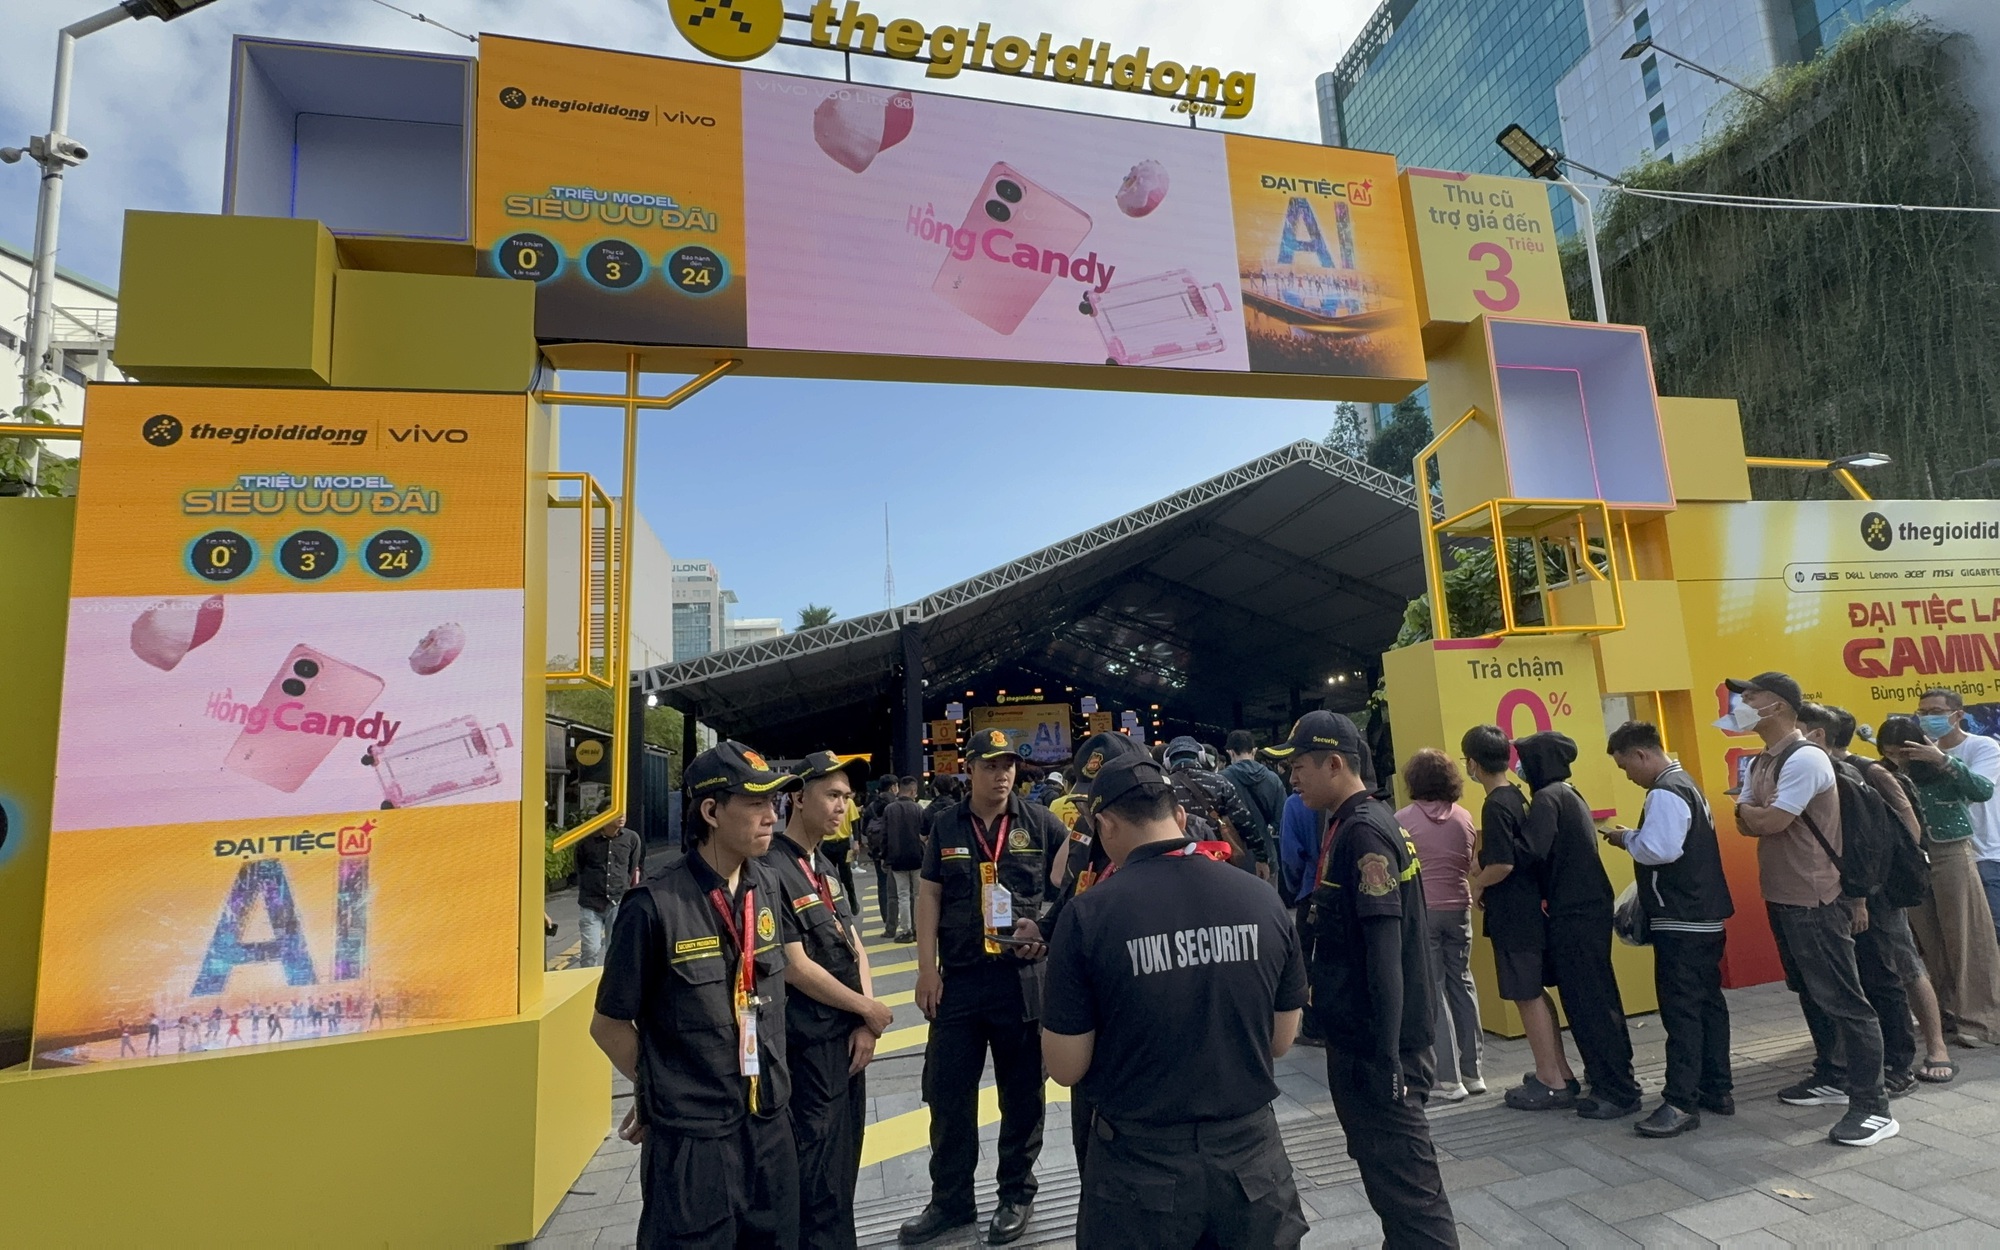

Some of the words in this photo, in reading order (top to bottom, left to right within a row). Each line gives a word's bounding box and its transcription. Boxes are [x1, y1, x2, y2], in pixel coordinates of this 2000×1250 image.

[810, 0, 1256, 119] thegioididong
[531, 95, 650, 122] thegioididong
[663, 111, 716, 127] vivo
[552, 186, 608, 202] TRIỆU
[613, 192, 679, 209] MODEL
[1261, 175, 1296, 196] ĐẠI
[1301, 178, 1346, 198] TIỆC
[1443, 183, 1484, 207] Thu
[1489, 188, 1514, 208] cũ
[506, 195, 590, 221] SIÊU
[600, 203, 653, 225] ƯU
[661, 207, 718, 231] ĐÃI
[1428, 205, 1461, 231] trợ
[1466, 207, 1498, 232] giá
[1502, 211, 1541, 234] đến
[1278, 197, 1355, 270] AI
[1506, 236, 1545, 255] Triệu
[518, 248, 537, 269] 0
[906, 202, 977, 261] Hồng
[981, 228, 1116, 294] Candy
[606, 262, 621, 280] 3
[682, 267, 711, 286] 24
[1468, 242, 1521, 313] 3
[190, 423, 368, 446] thegioididong
[388, 424, 469, 443] vivo
[239, 473, 307, 491] TRIỆU
[314, 475, 394, 489] MODEL
[184, 486, 285, 514] SIÊU
[296, 490, 361, 514] ƯU
[371, 487, 438, 514] ĐÃI
[211, 546, 230, 568] 0
[300, 553, 316, 571] 3
[378, 552, 409, 570] 24
[1811, 572, 1839, 581] ASUS
[1870, 571, 1898, 579] Lenovo
[1904, 570, 1926, 578] acer
[1932, 569, 1955, 577] msi
[1849, 601, 1896, 633] ĐẠI
[1901, 593, 1966, 630] TIỆC
[1467, 657, 1502, 679] Trả
[1507, 656, 1564, 681] chậm
[1871, 685, 1905, 701] Bùng
[1907, 680, 1922, 697] nổ
[1954, 680, 1984, 696] năng
[204, 687, 270, 735] Hồng
[272, 702, 401, 747] Candy
[1313, 736, 1339, 746] Security
[213, 836, 264, 859] ĐẠI
[268, 829, 336, 855] TIỆC
[189, 856, 369, 998] AI
[1127, 933, 1172, 976] YUKI
[1175, 924, 1259, 968] SECURITY
